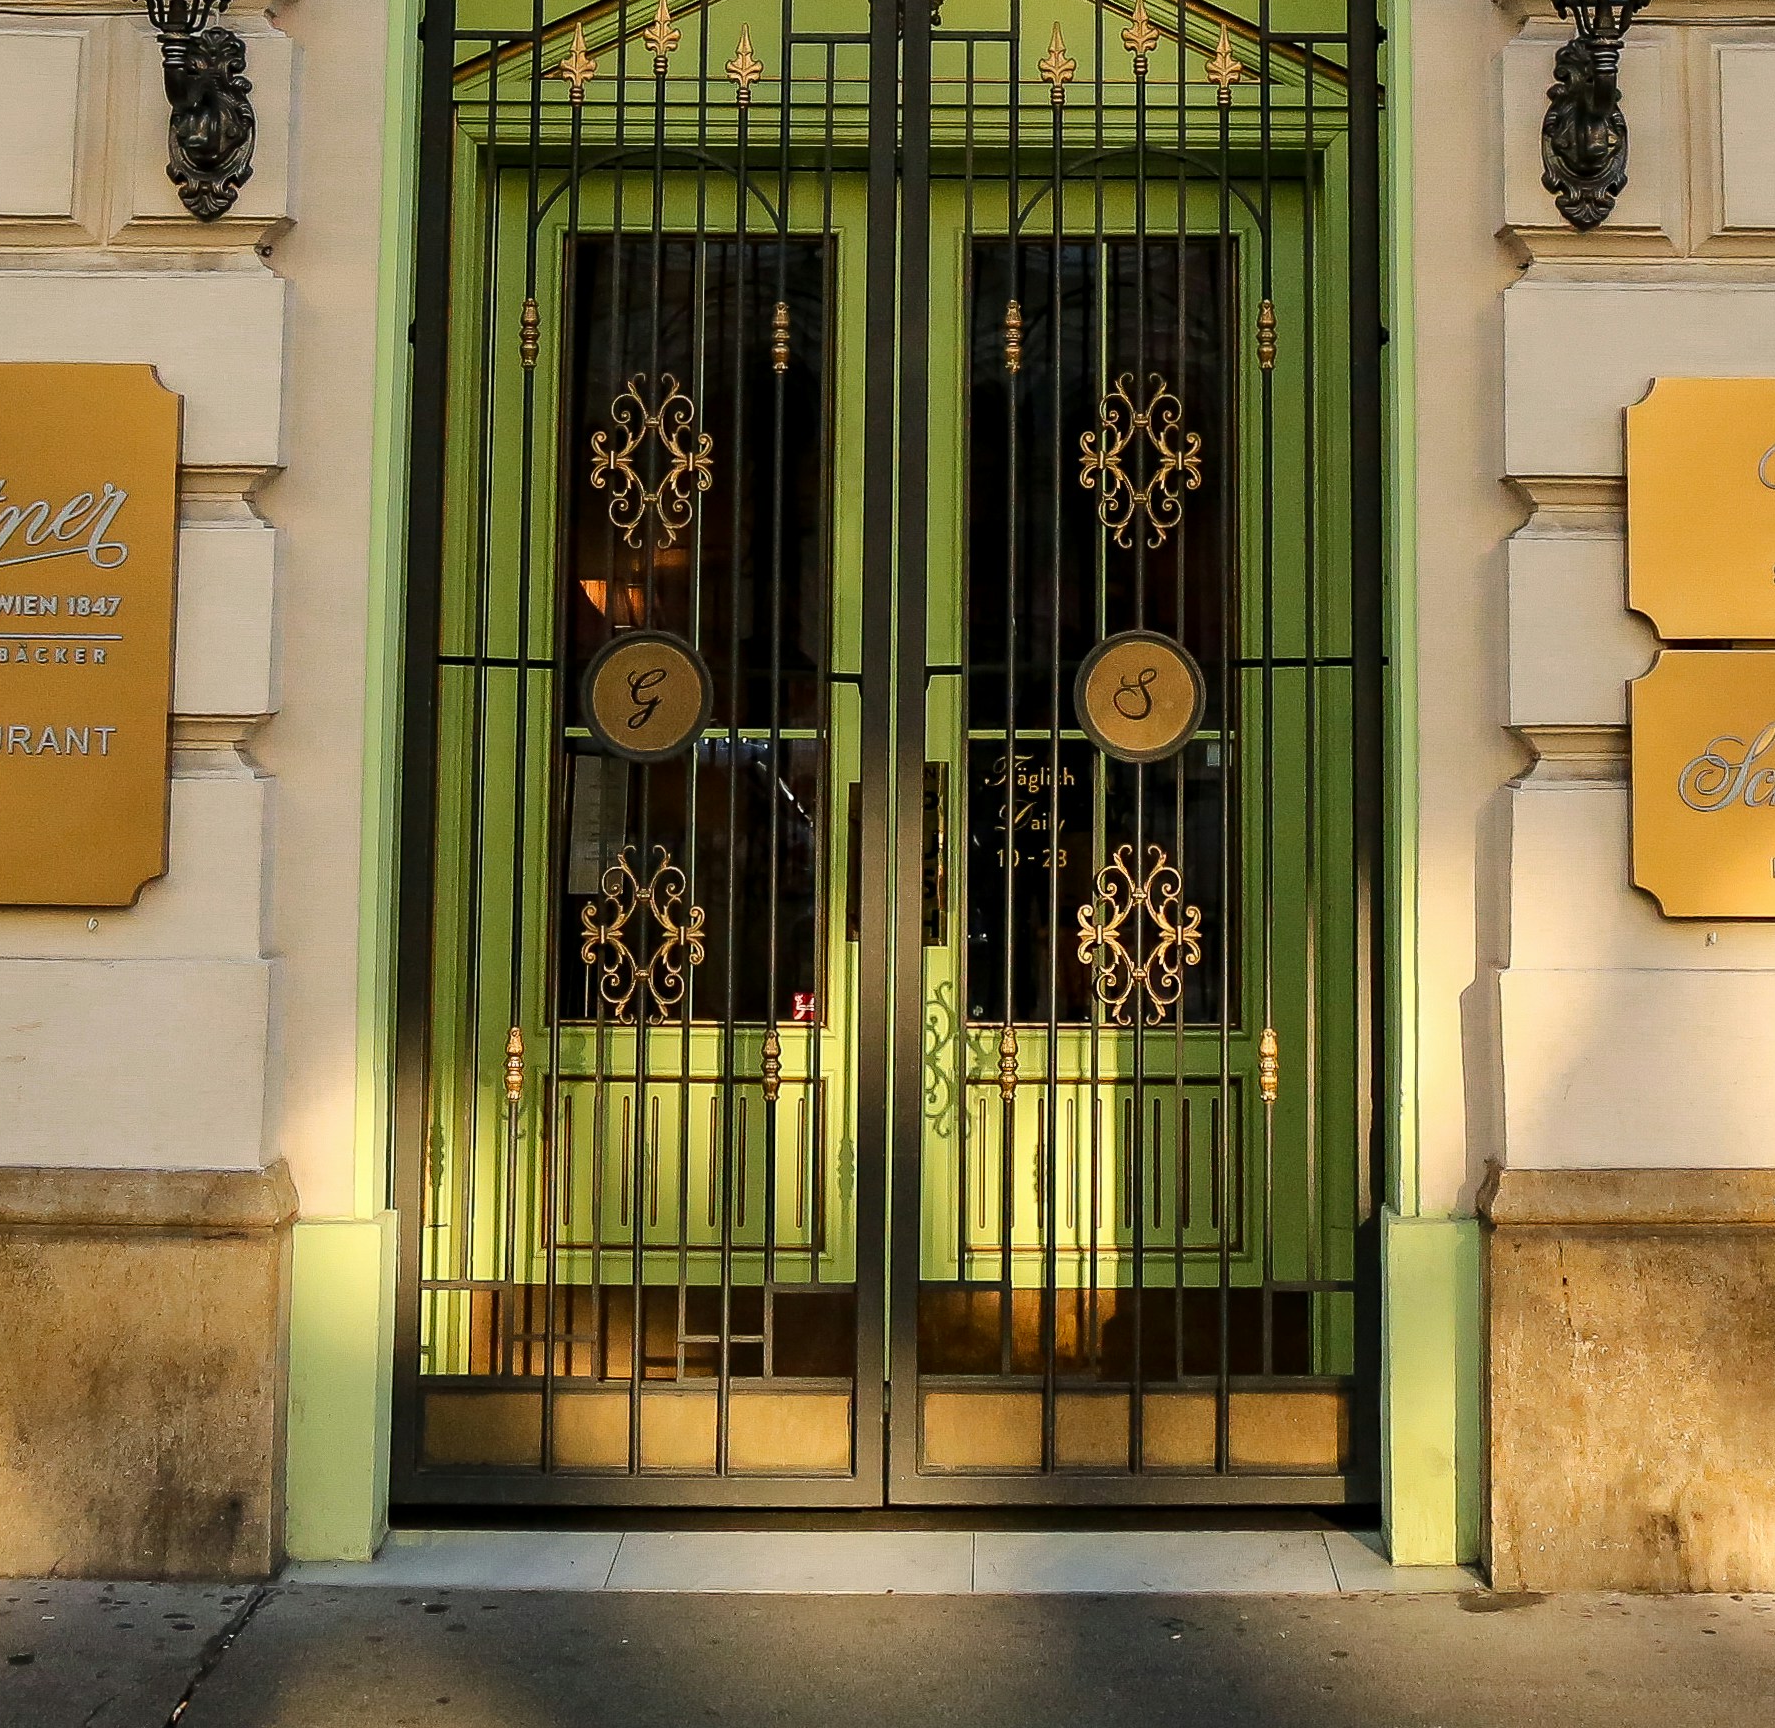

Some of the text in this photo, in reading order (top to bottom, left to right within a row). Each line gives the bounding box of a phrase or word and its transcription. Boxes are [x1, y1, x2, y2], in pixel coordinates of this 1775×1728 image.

[66, 595, 122, 617] 1847
[627, 668, 667, 729] G
[1113, 667, 1157, 720] S
[985, 753, 1075, 793] Täglih
